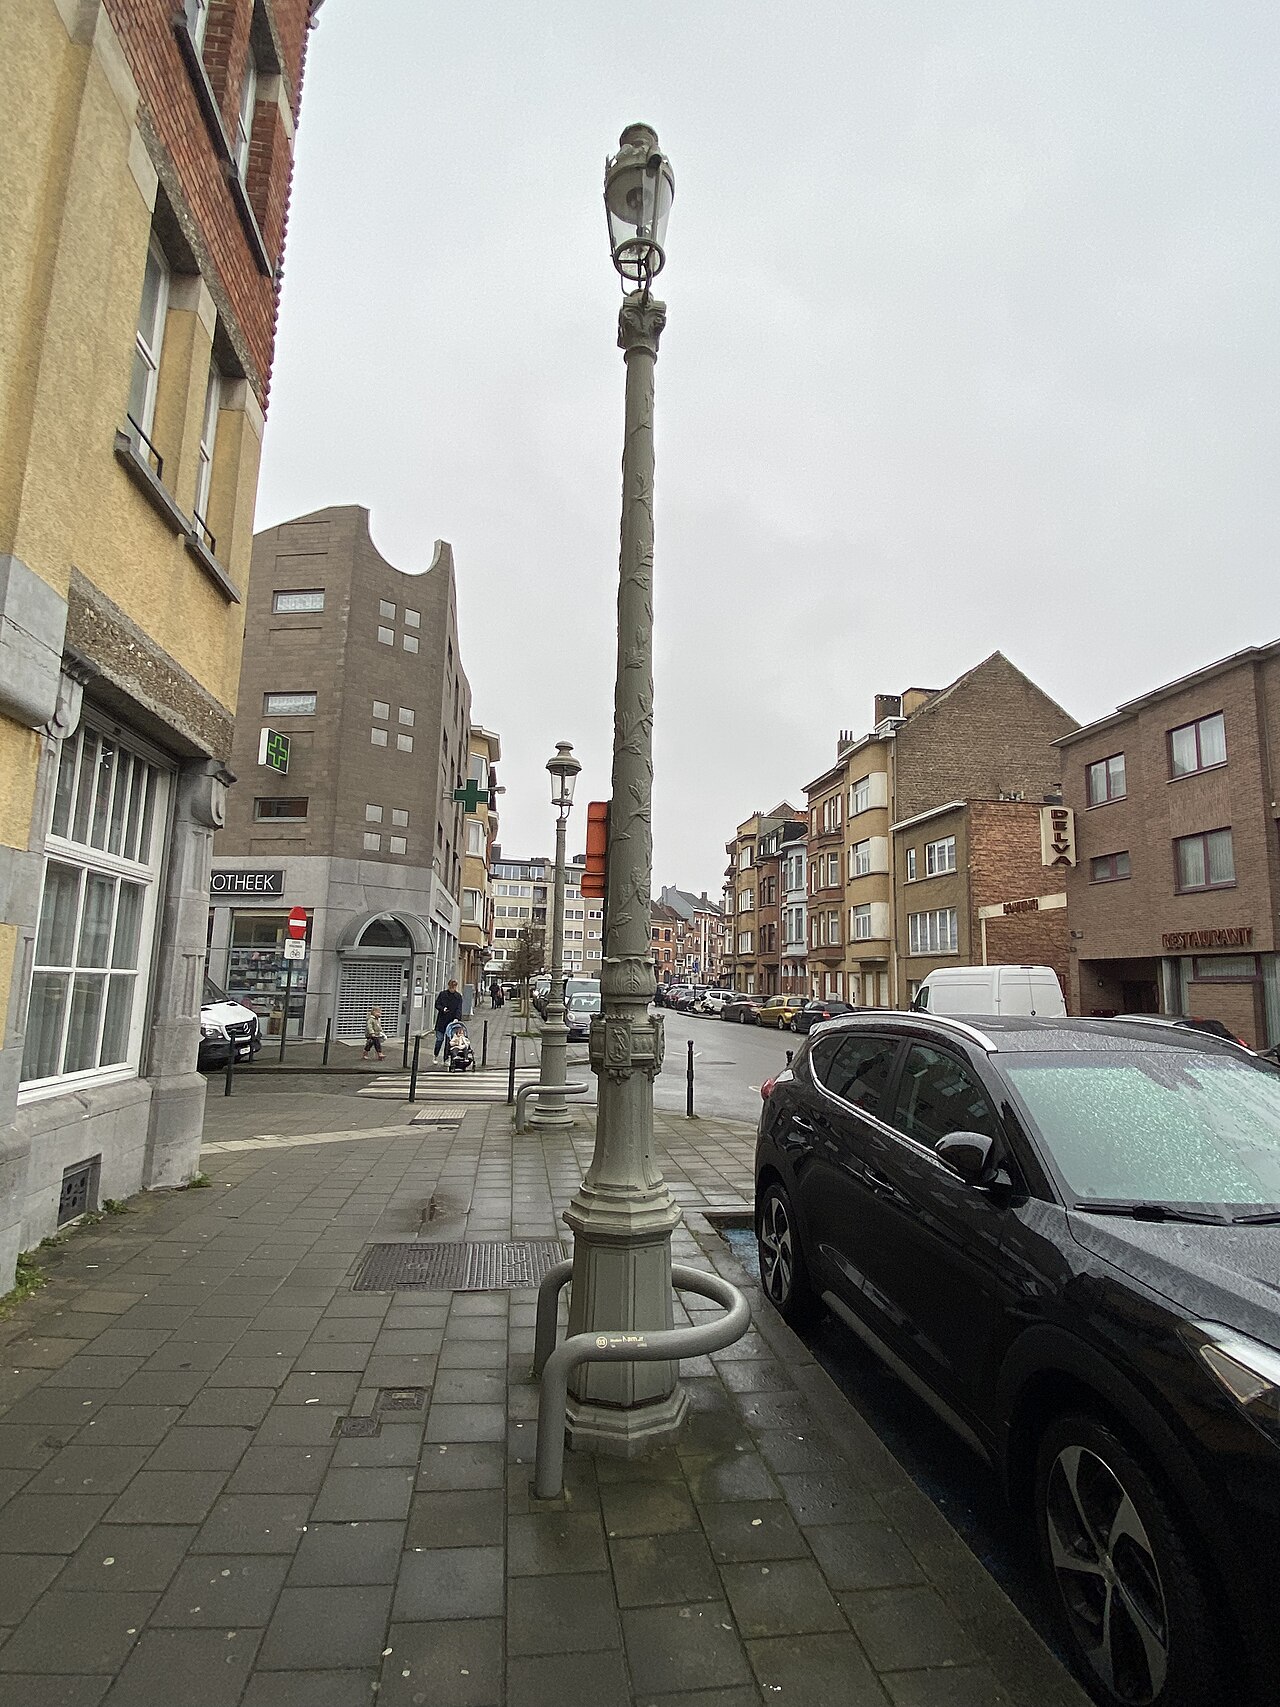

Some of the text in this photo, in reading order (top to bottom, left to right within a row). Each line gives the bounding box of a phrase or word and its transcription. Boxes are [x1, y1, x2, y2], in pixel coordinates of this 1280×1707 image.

[1050, 809, 1073, 866] DELVA
[210, 874, 275, 891] OTHEEK
[1162, 928, 1252, 949] RESTAURANT
